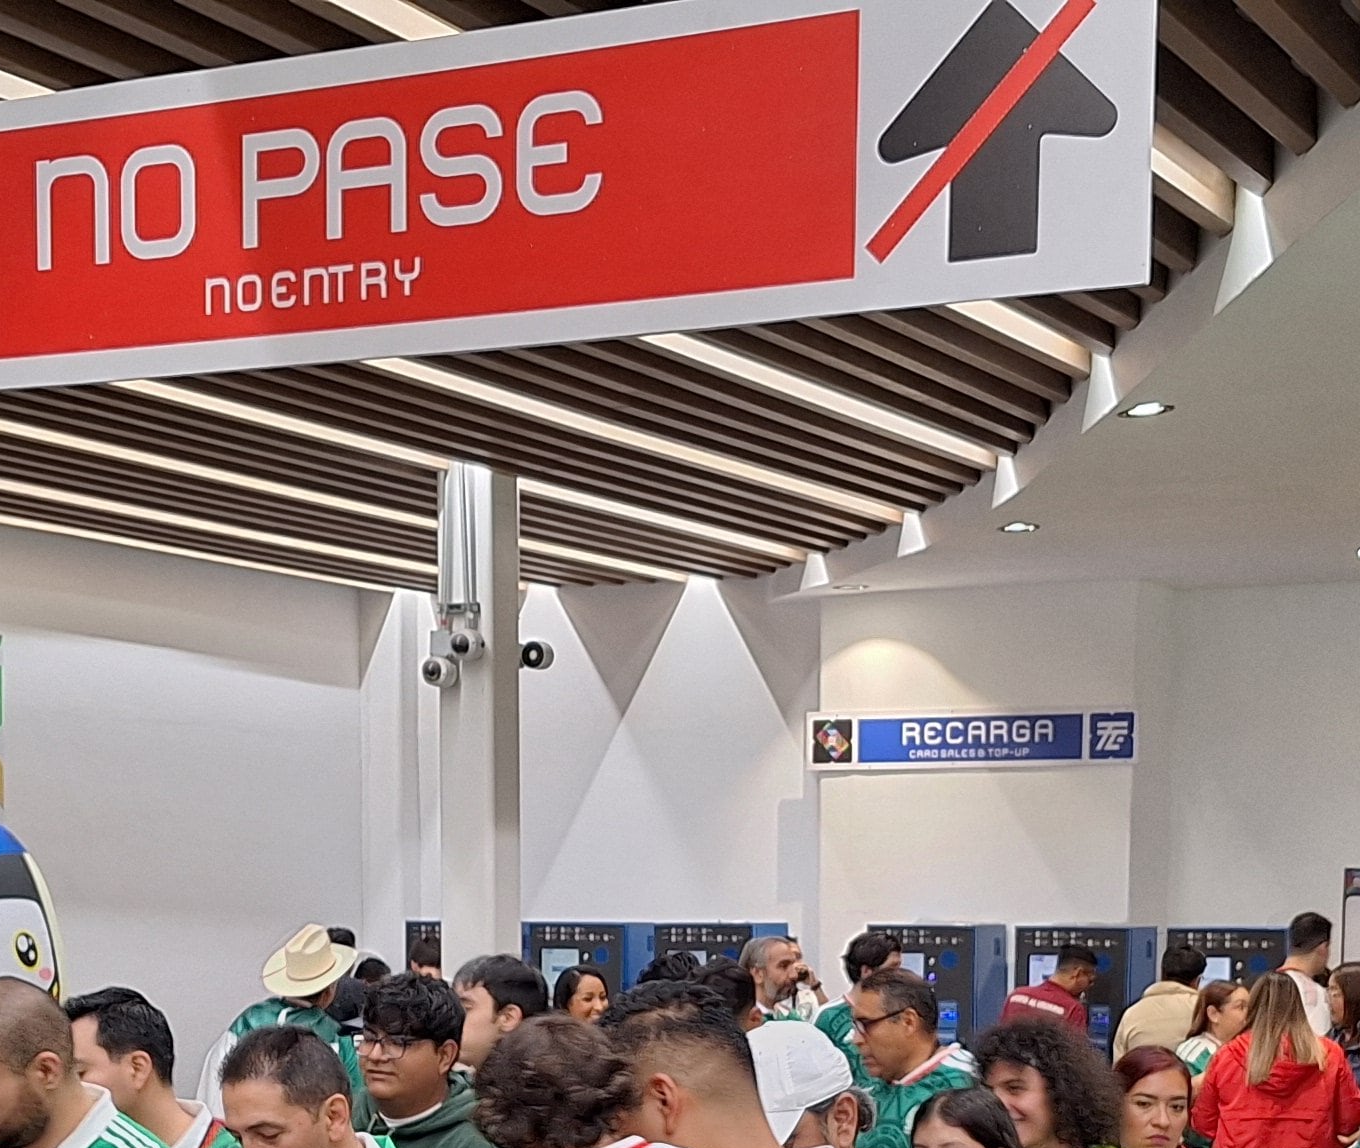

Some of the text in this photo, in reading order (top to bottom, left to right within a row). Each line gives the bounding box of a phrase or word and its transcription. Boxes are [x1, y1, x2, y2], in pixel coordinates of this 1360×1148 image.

[35, 89, 604, 272] NO PASE
[901, 719, 1055, 746] RECARGA
[987, 747, 1030, 758] TOP-UP
